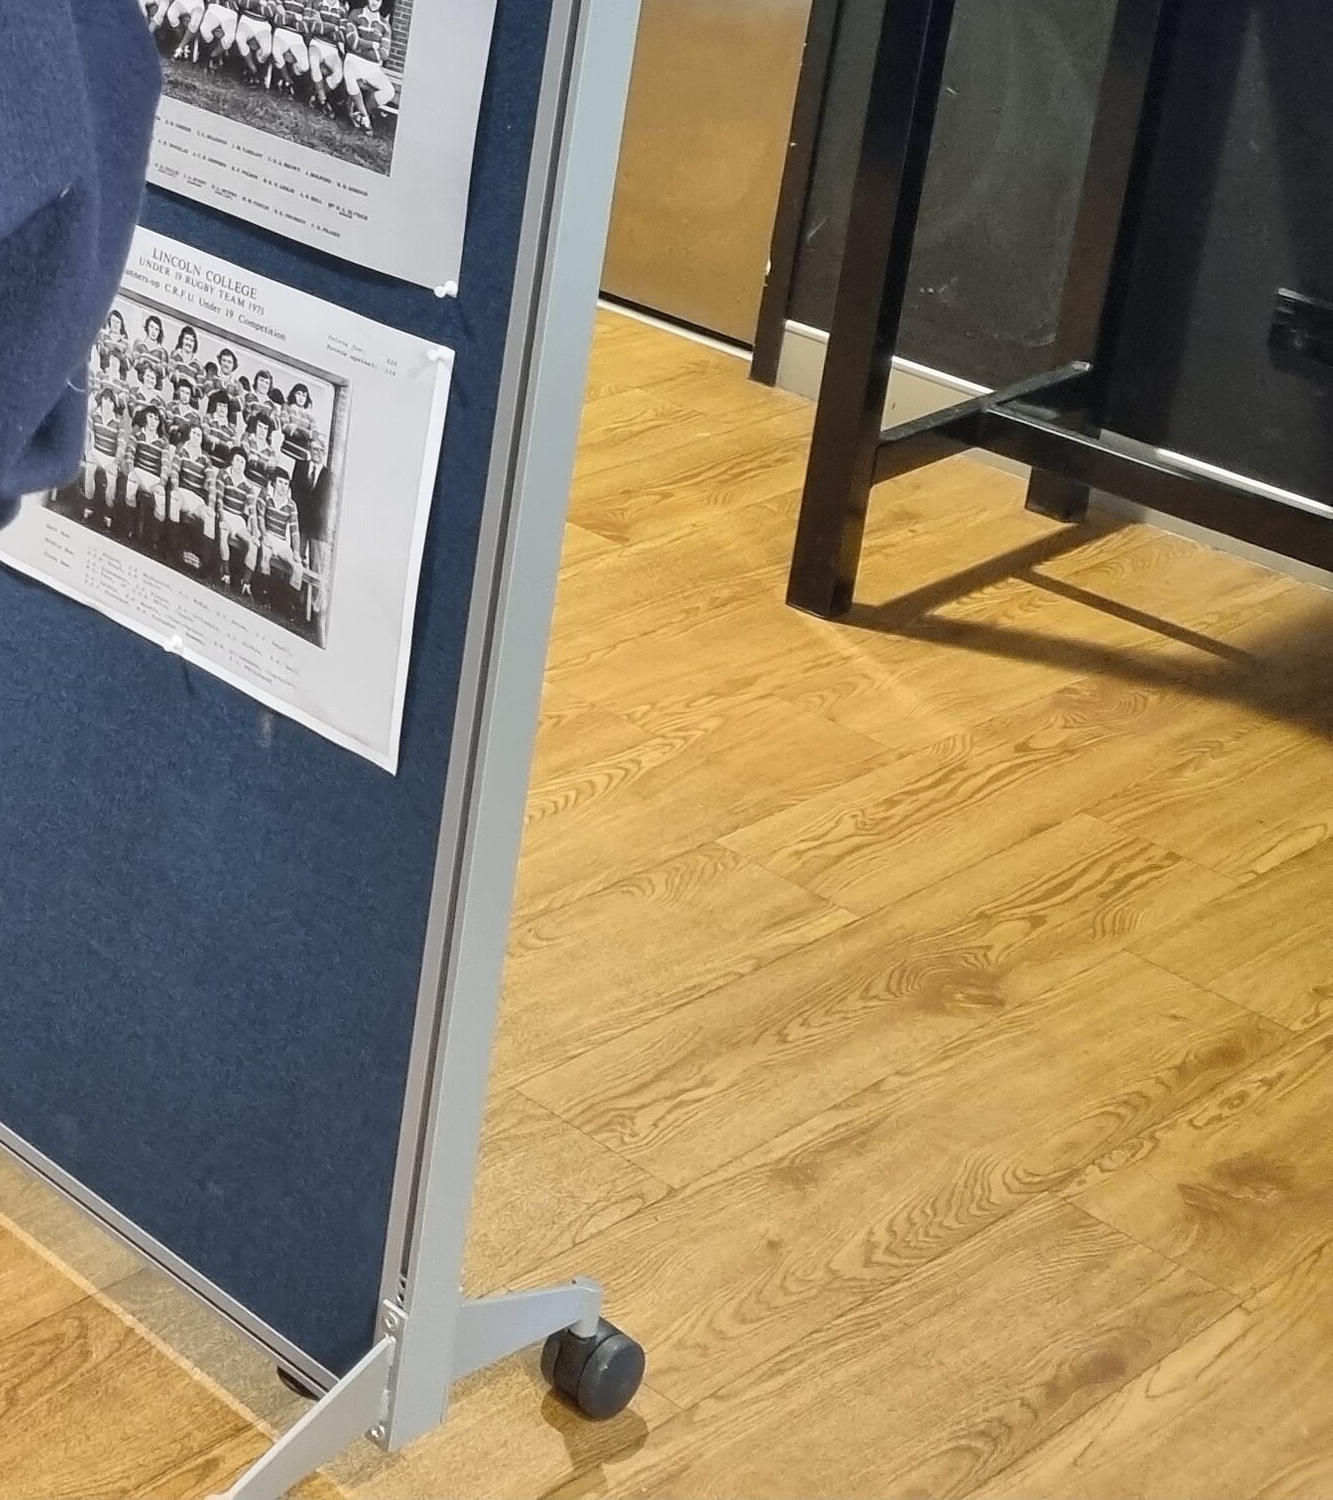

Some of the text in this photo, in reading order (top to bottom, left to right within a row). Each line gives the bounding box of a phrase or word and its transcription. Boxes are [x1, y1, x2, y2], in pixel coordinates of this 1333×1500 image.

[138, 257, 265, 316] UNDER 19 RUGBY TEAM 1975
[152, 247, 257, 300] LINCOLN COLLEGE
[198, 297, 222, 315] Under
[225, 309, 234, 318] 19
[238, 314, 287, 341] Competition
